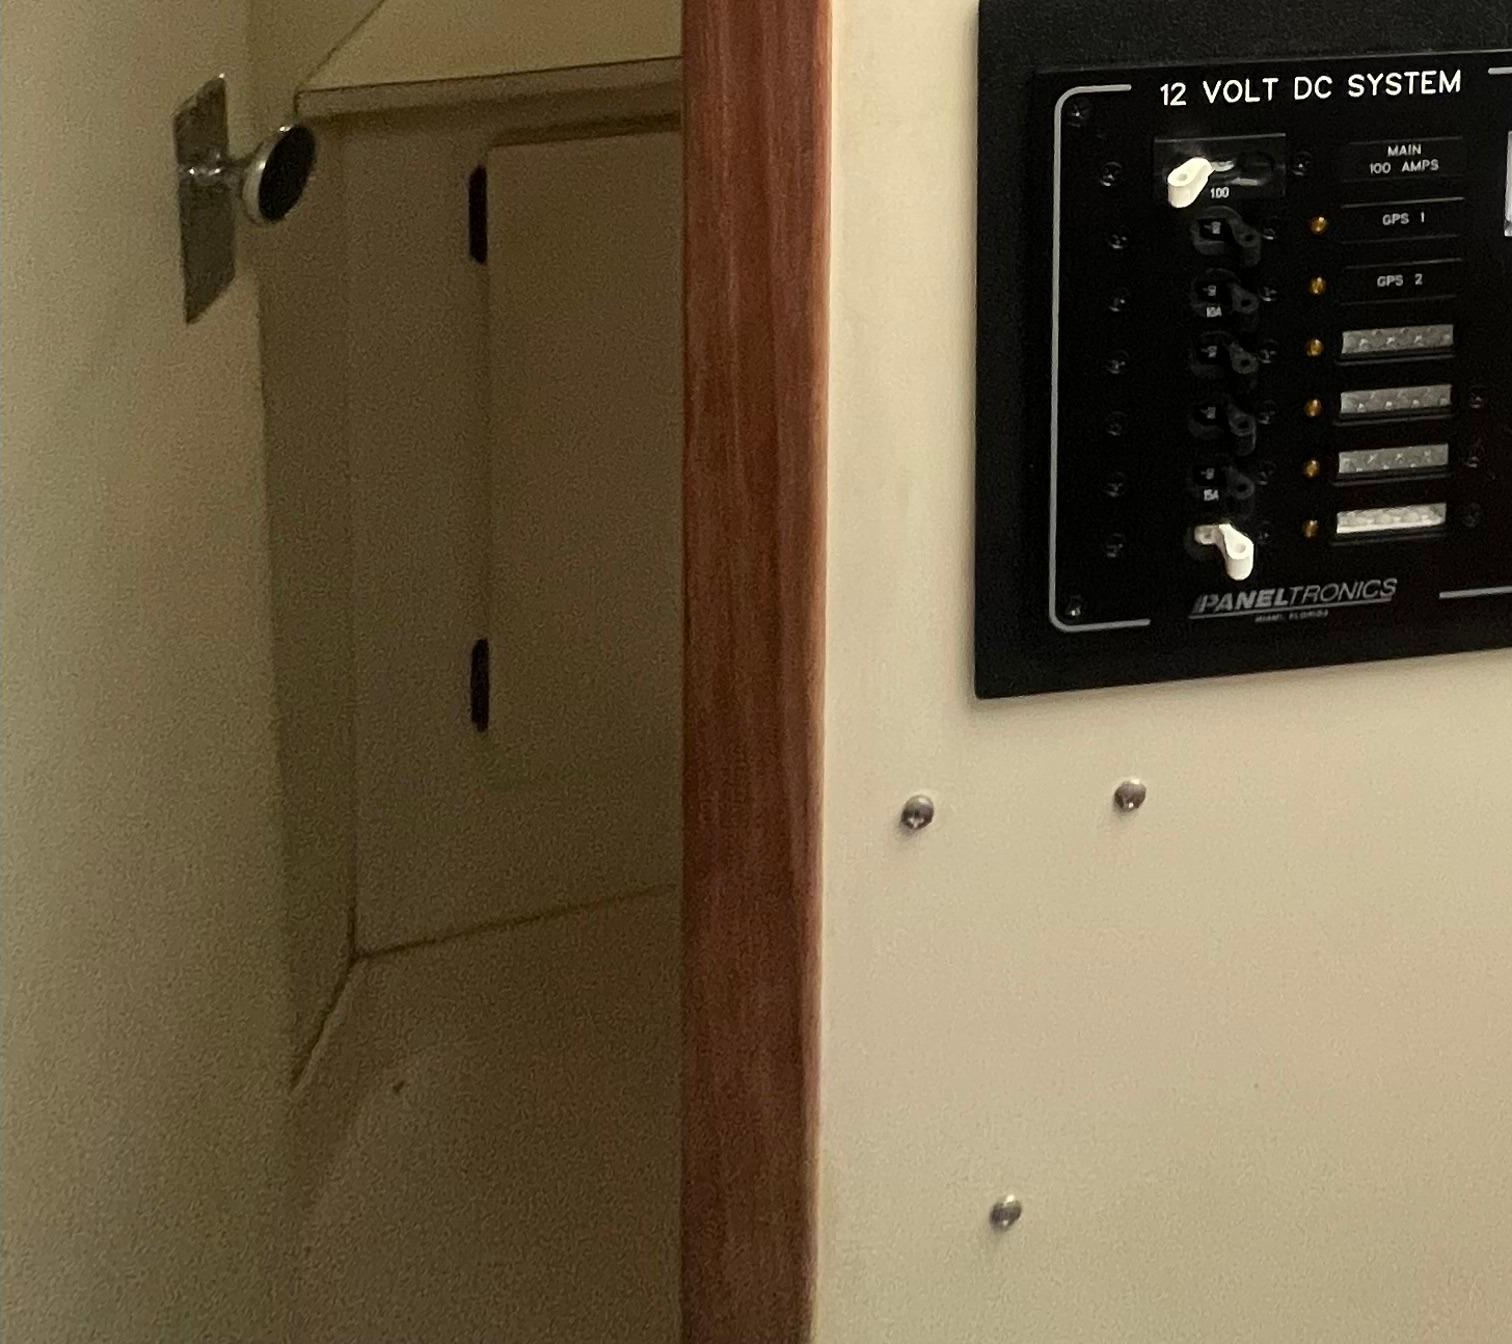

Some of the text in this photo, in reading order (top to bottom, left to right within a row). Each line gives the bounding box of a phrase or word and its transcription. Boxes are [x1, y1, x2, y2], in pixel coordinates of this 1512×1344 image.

[1159, 69, 1462, 106] 12 VOLT DC SYSTEM
[1387, 143, 1422, 158] MAIN
[1369, 158, 1440, 175] 100 AMPS
[1210, 186, 1230, 199] 100
[1382, 212, 1410, 227] GPS
[1376, 273, 1423, 289] GPS 2
[1192, 577, 1398, 614] PANELTRONICS
